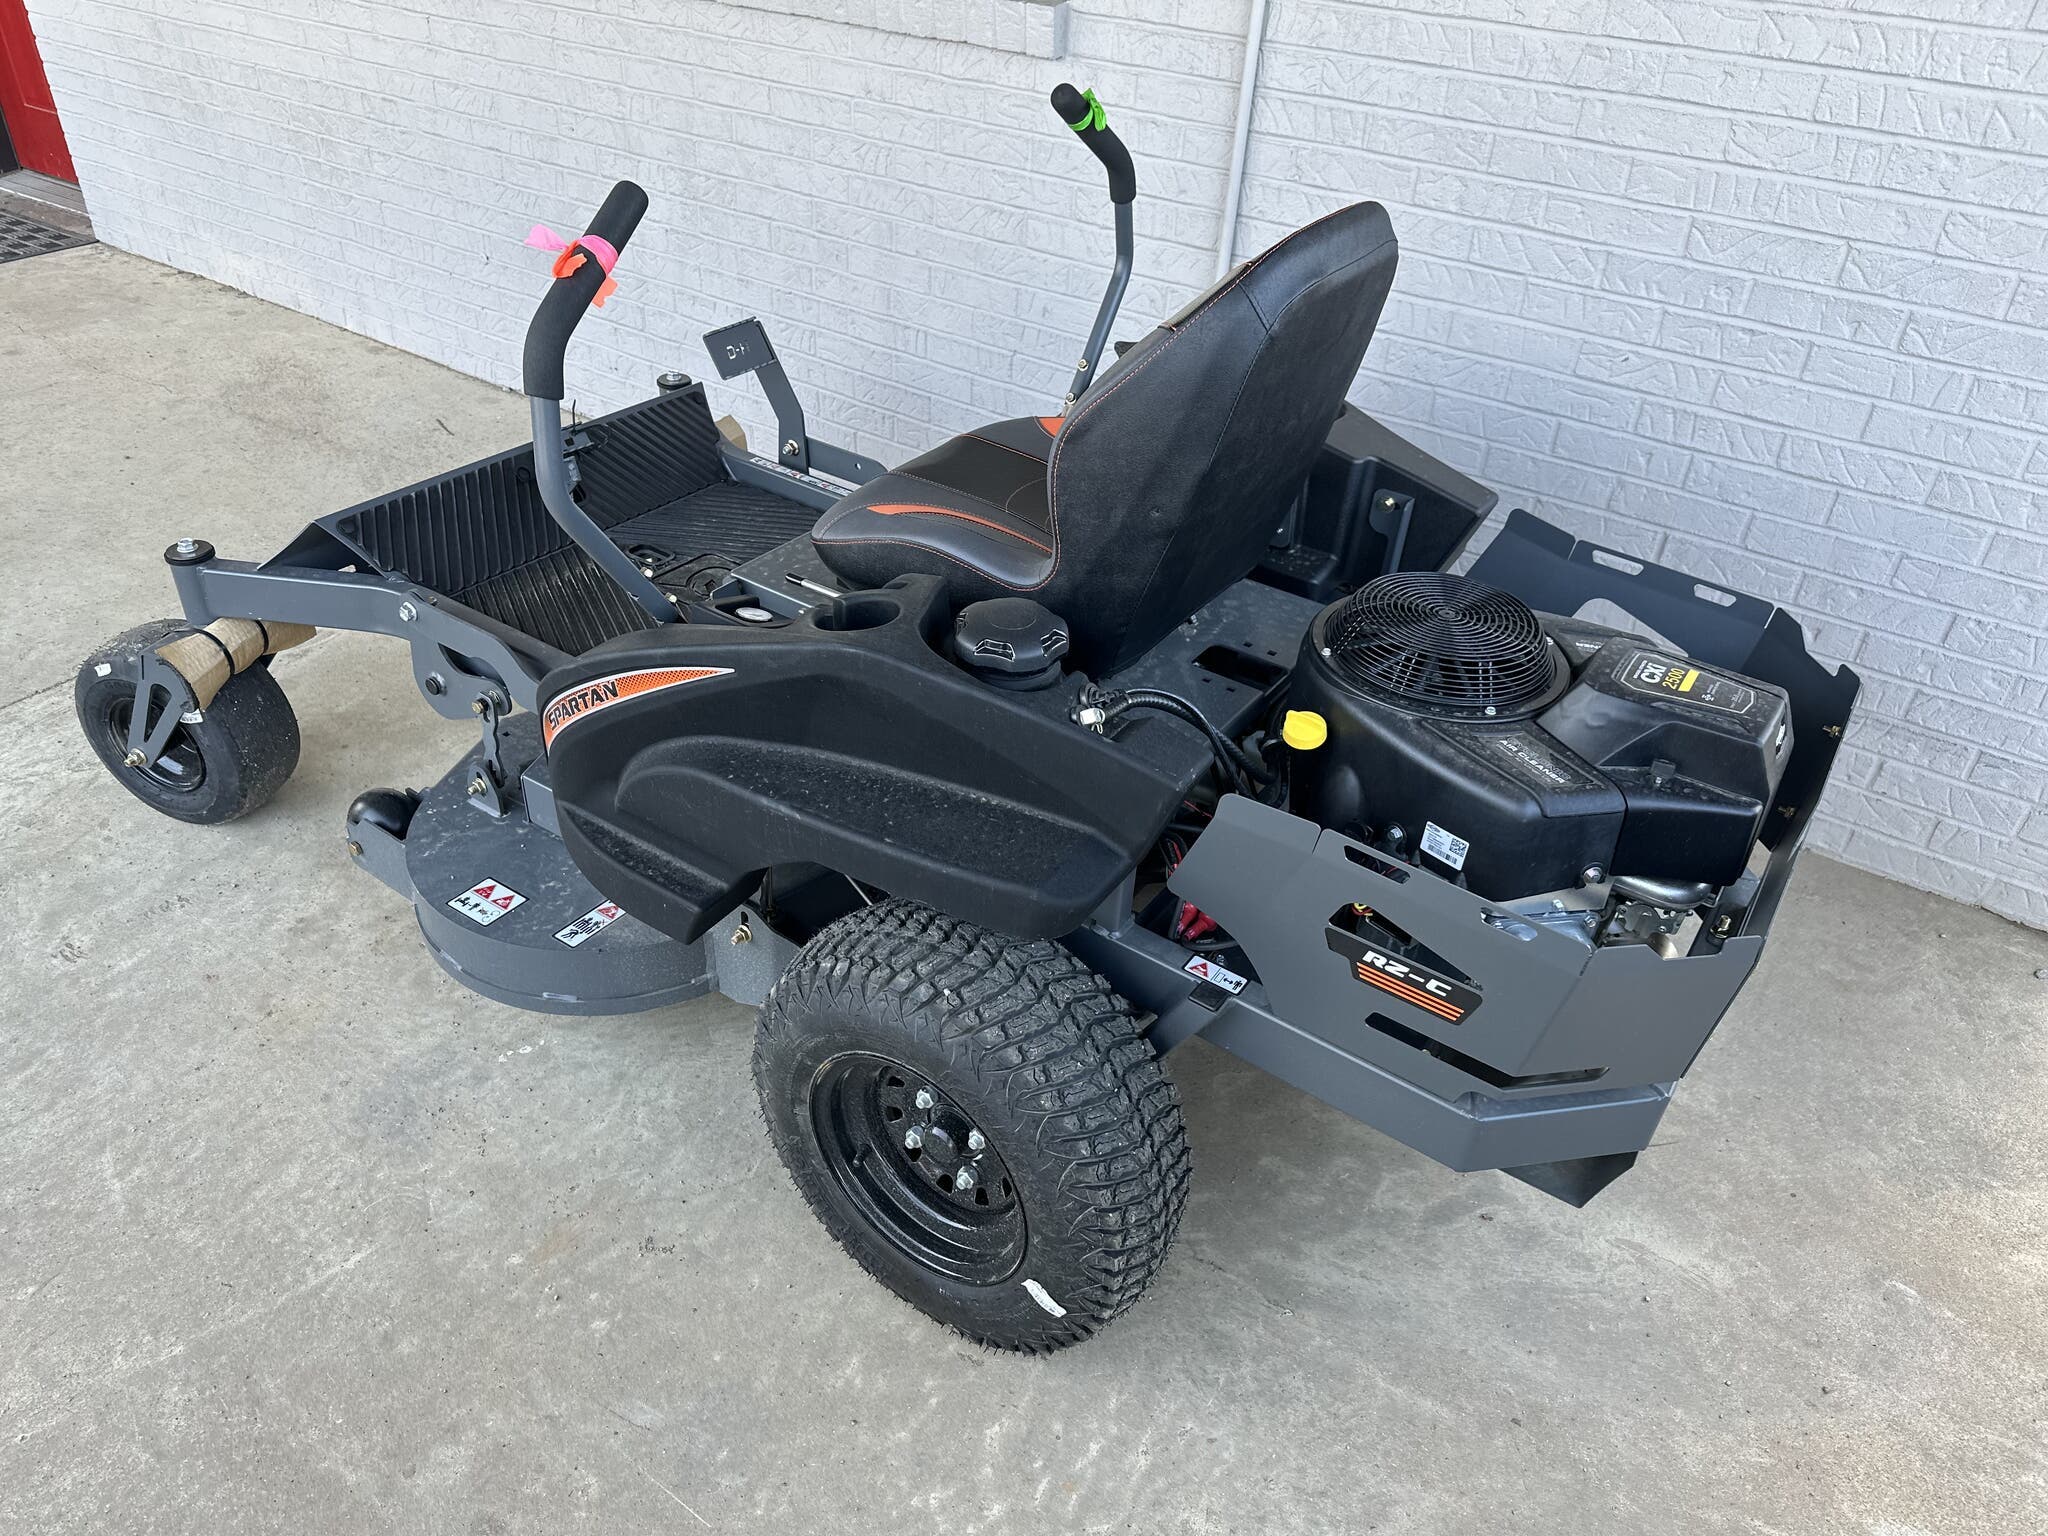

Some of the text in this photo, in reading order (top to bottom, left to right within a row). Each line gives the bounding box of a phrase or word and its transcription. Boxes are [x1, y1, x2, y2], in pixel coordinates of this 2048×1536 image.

[1662, 668, 1686, 690] 2500
[548, 681, 619, 730] SPARTAN
[1500, 740, 1518, 752] AIR
[1518, 752, 1566, 783] CLEANER
[1362, 950, 1452, 998] RZ-C
